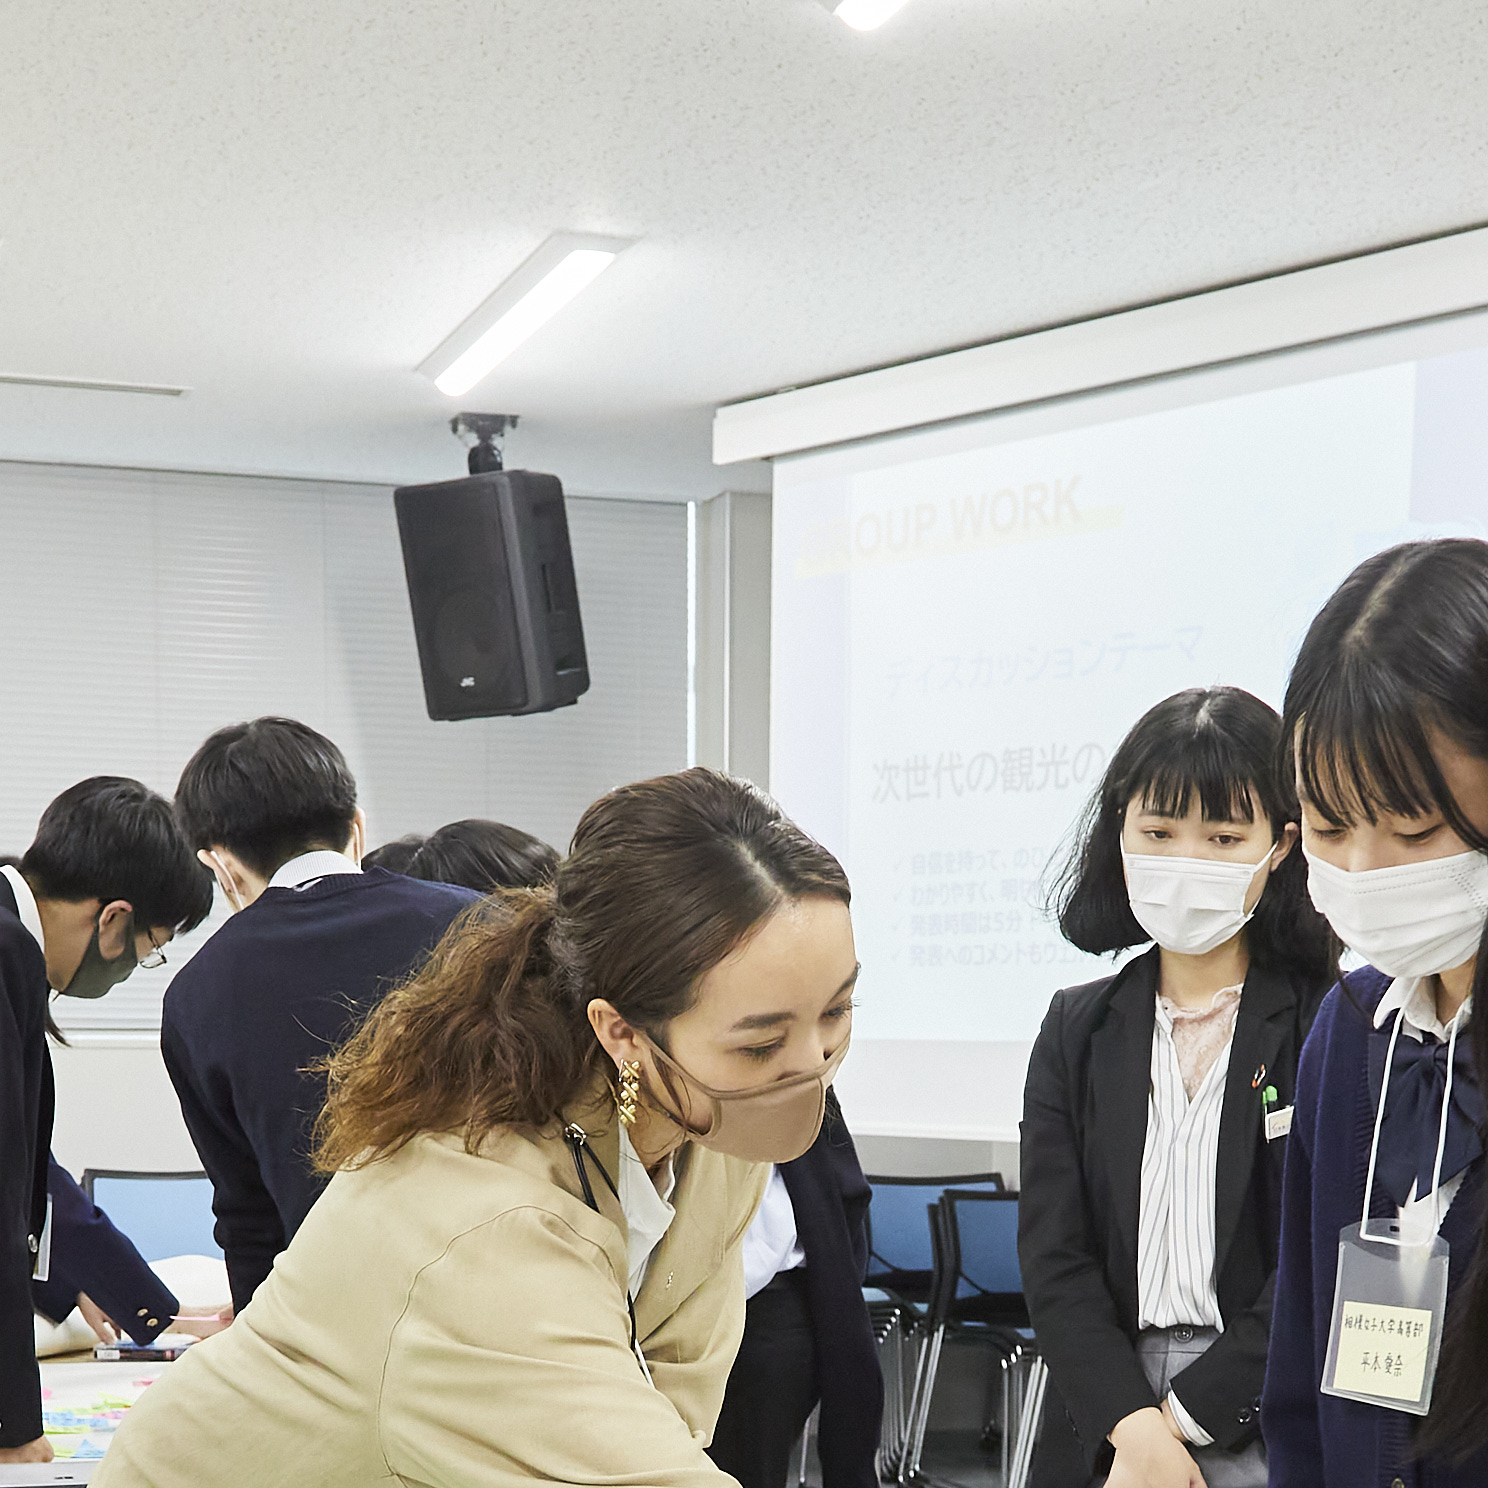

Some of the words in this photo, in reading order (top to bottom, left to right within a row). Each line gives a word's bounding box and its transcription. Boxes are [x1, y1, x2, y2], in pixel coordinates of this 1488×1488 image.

[950, 474, 1083, 538] WORK
[884, 625, 1204, 698] ディスカッションテーマ
